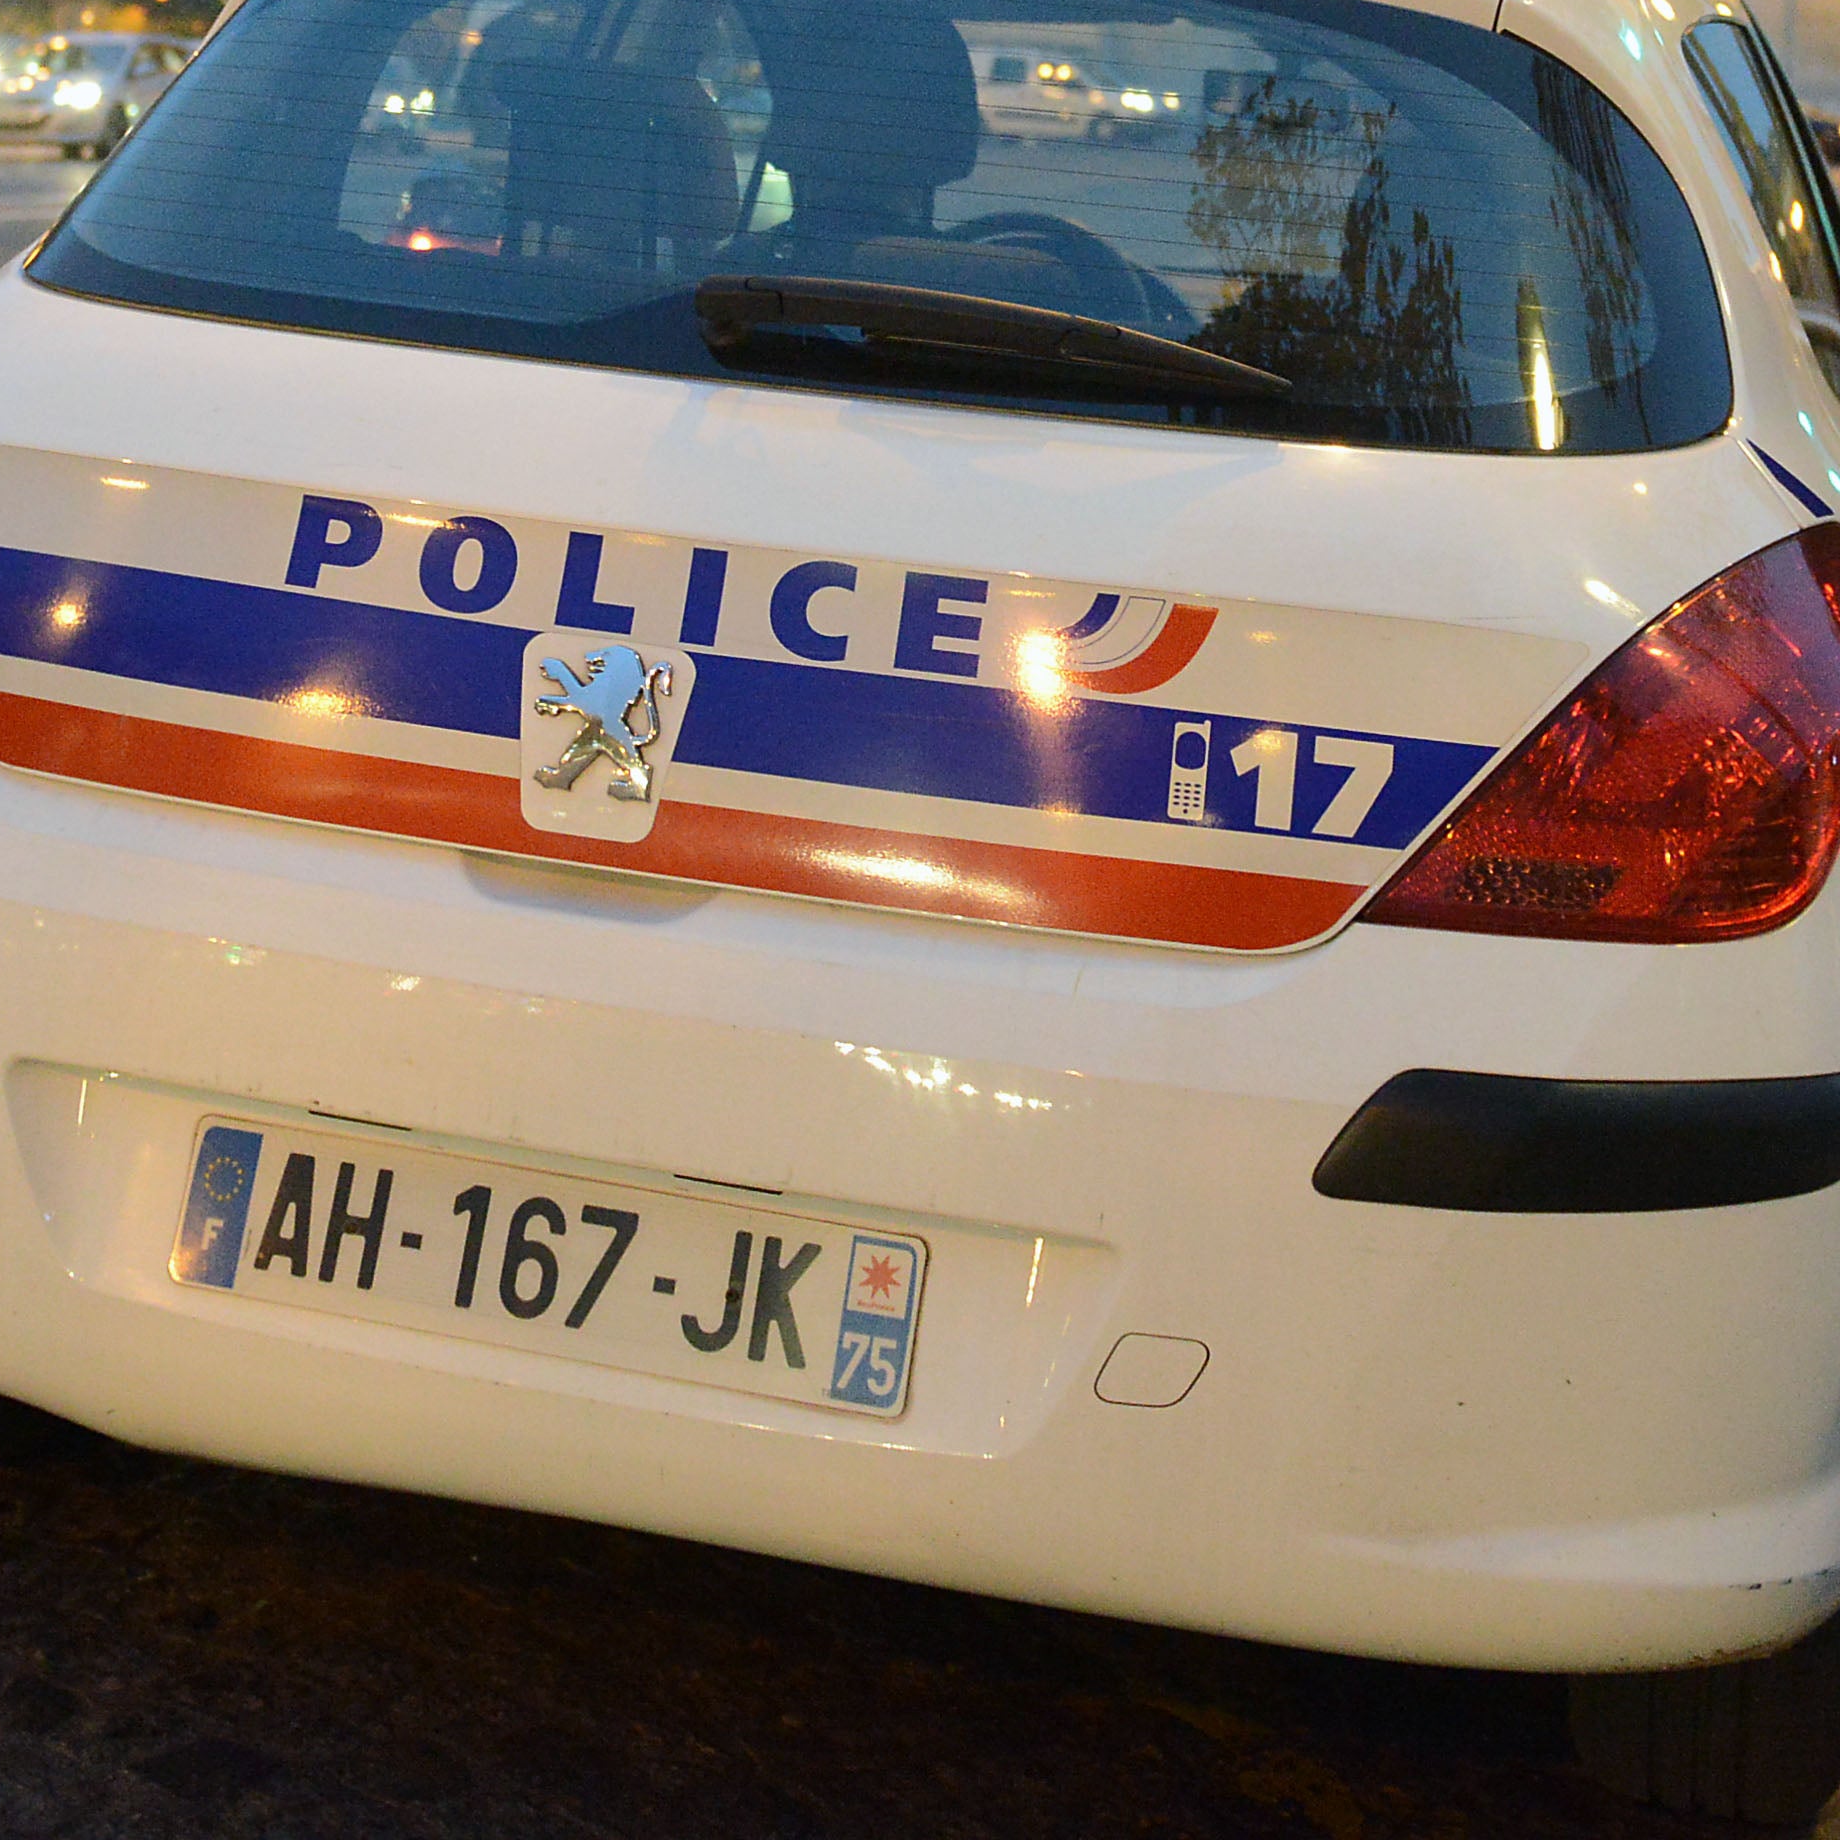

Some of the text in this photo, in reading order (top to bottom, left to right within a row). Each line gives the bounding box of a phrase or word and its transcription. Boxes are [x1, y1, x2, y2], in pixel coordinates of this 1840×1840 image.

[283, 493, 991, 679] POLICE
[1229, 729, 1395, 839] 17
[201, 1217, 225, 1251] F
[253, 1152, 822, 1370] AH-167-JK
[836, 1330, 897, 1397] 75
